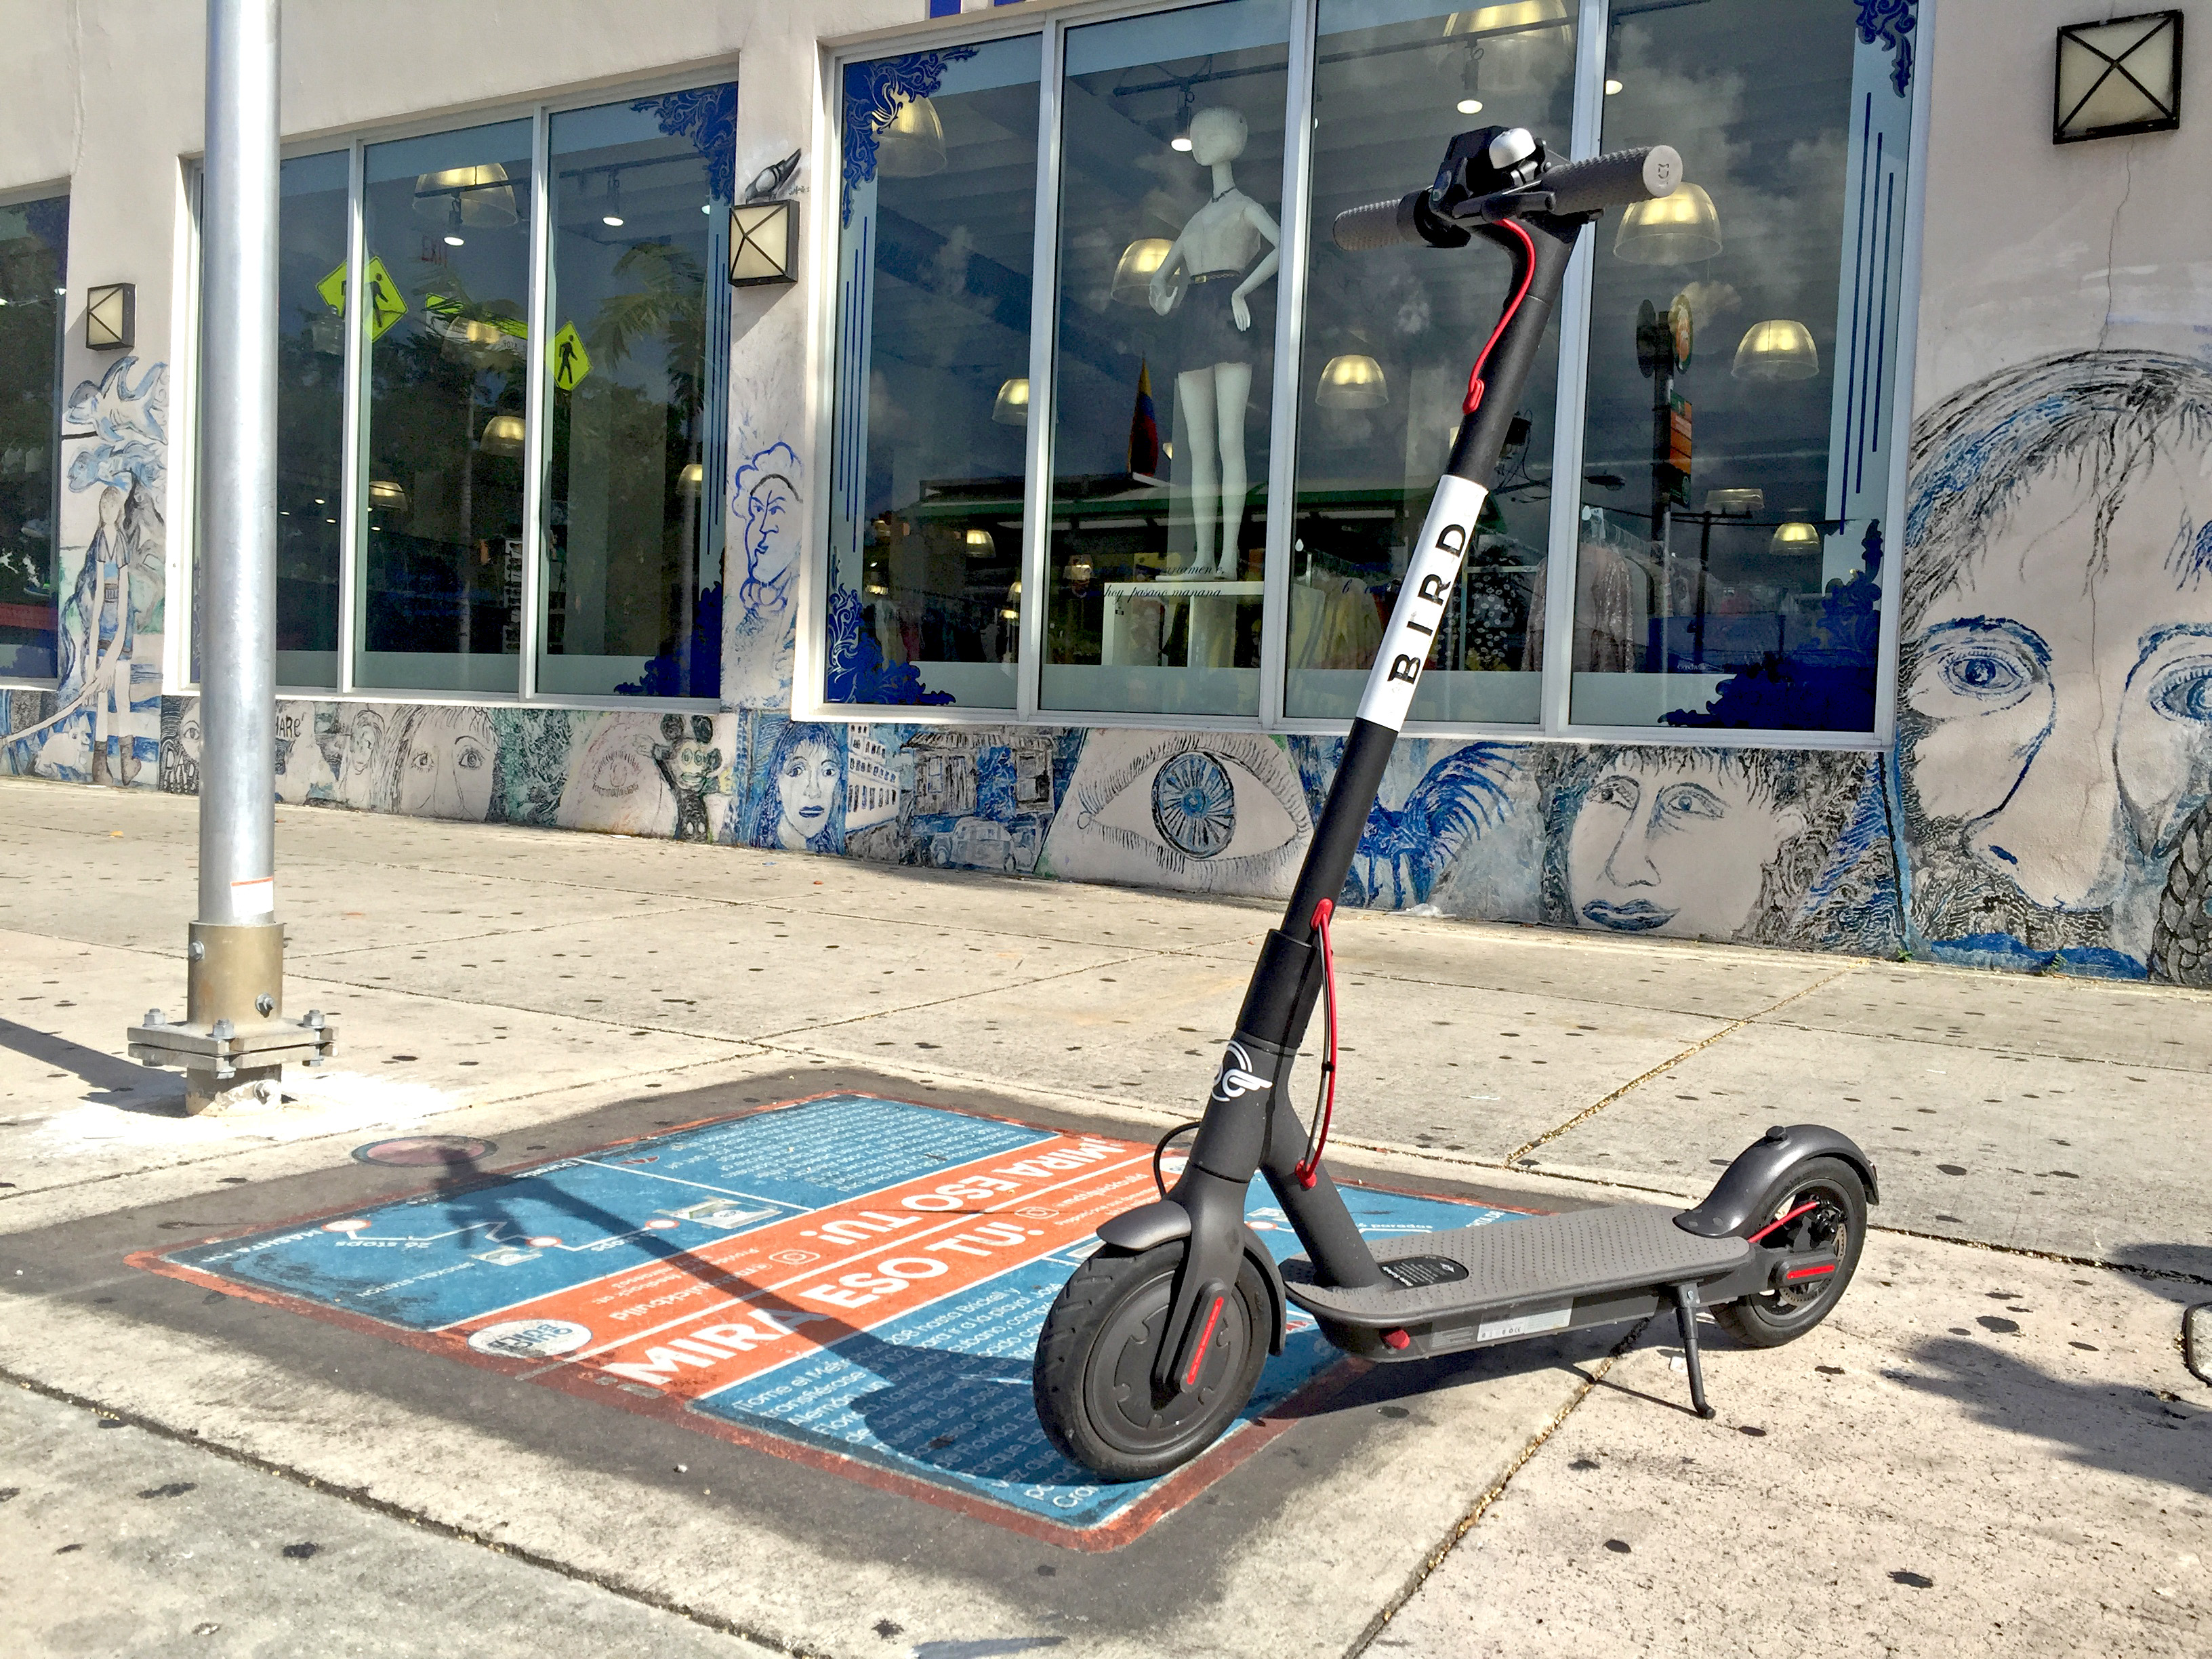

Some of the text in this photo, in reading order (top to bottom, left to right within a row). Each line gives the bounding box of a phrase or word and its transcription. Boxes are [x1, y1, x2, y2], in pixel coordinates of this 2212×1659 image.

[1387, 524, 1467, 685] BIRD
[882, 1139, 924, 1150] bought
[512, 1160, 583, 1179] Duratio
[840, 1160, 886, 1170] known
[864, 1170, 908, 1183] Brickell
[838, 1183, 864, 1191] and
[902, 1176, 1016, 1212] ESO
[1052, 1172, 1149, 1208] @mdtquickbuild
[243, 1229, 323, 1253] MASHTA
[590, 1229, 656, 1252] stops
[803, 1211, 918, 1244] TU!
[335, 1240, 396, 1248] stops
[806, 1258, 946, 1305] ESO
[928, 1223, 1040, 1258] TU!
[610, 1262, 772, 1319] @mdtquickbuild
[487, 1324, 560, 1351] BUILD
[505, 1327, 573, 1353] QUICK
[792, 1376, 811, 1386] el
[883, 1330, 918, 1344] 208
[915, 1312, 962, 1330] hasta
[956, 1291, 1006, 1312] Brickell
[861, 1381, 893, 1391] un
[948, 1326, 1010, 1351] cubano,
[952, 1337, 1021, 1369] conocido
[846, 1428, 869, 1442] de
[863, 1400, 933, 1428] James
[992, 1359, 1017, 1369] en
[937, 1406, 963, 1418] de
[964, 1385, 1002, 1406] José
[933, 1453, 962, 1469] de
[992, 1469, 1029, 1487] vez
